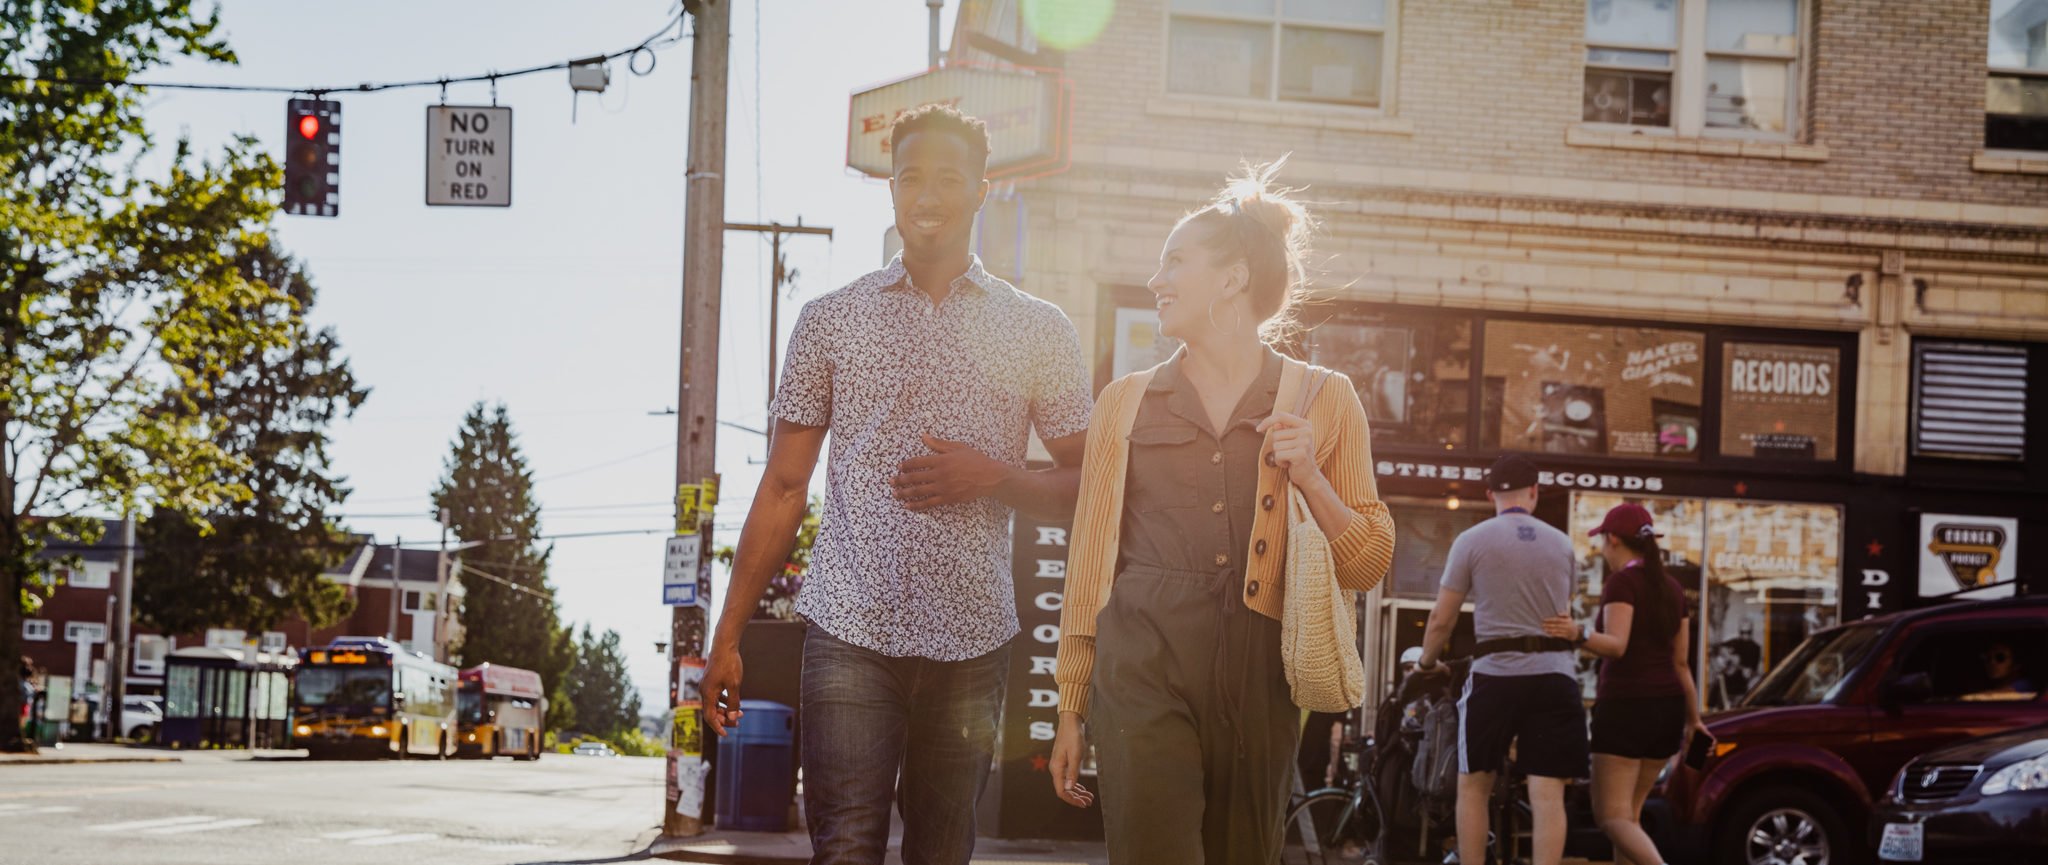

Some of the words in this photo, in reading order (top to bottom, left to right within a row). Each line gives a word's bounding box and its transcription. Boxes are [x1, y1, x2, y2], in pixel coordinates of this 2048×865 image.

[450, 112, 489, 134] NO
[444, 138, 495, 155] TURN
[456, 160, 482, 177] ON
[450, 182, 488, 200] RED
[1621, 353, 1698, 381] GIANTS
[1626, 341, 1697, 367] NAKED
[1731, 359, 1831, 396] RECORDS
[1376, 461, 1491, 481] STREE
[1537, 471, 1664, 492] ECORDS
[1715, 551, 1799, 573] BERGMAN
[1861, 568, 1889, 621] DI
[1028, 526, 1067, 741] RECORDS
